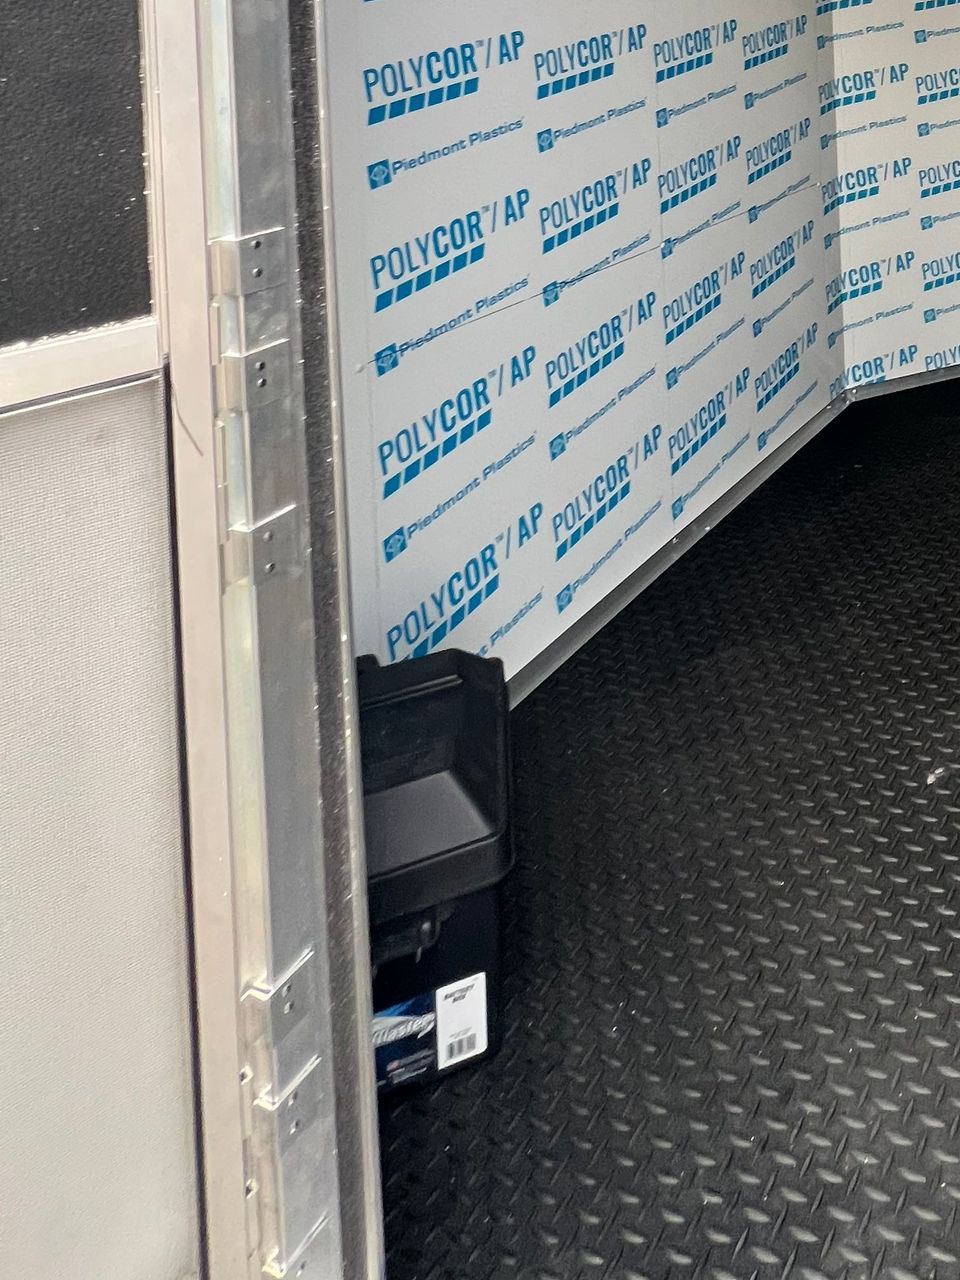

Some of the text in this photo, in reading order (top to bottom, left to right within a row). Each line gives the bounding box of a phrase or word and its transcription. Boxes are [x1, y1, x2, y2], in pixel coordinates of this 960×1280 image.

[498, 29, 524, 65] AP
[391, 119, 523, 175] Piedmont Plastics
[504, 187, 530, 227] AP
[398, 276, 528, 357] Piedmont Plastics
[637, 290, 656, 326] AP
[510, 344, 536, 388] AP
[565, 395, 616, 443] Piedmont
[406, 434, 535, 539] Piedmont Plastics
[518, 501, 543, 549] AP
[490, 590, 542, 647] Plastics
